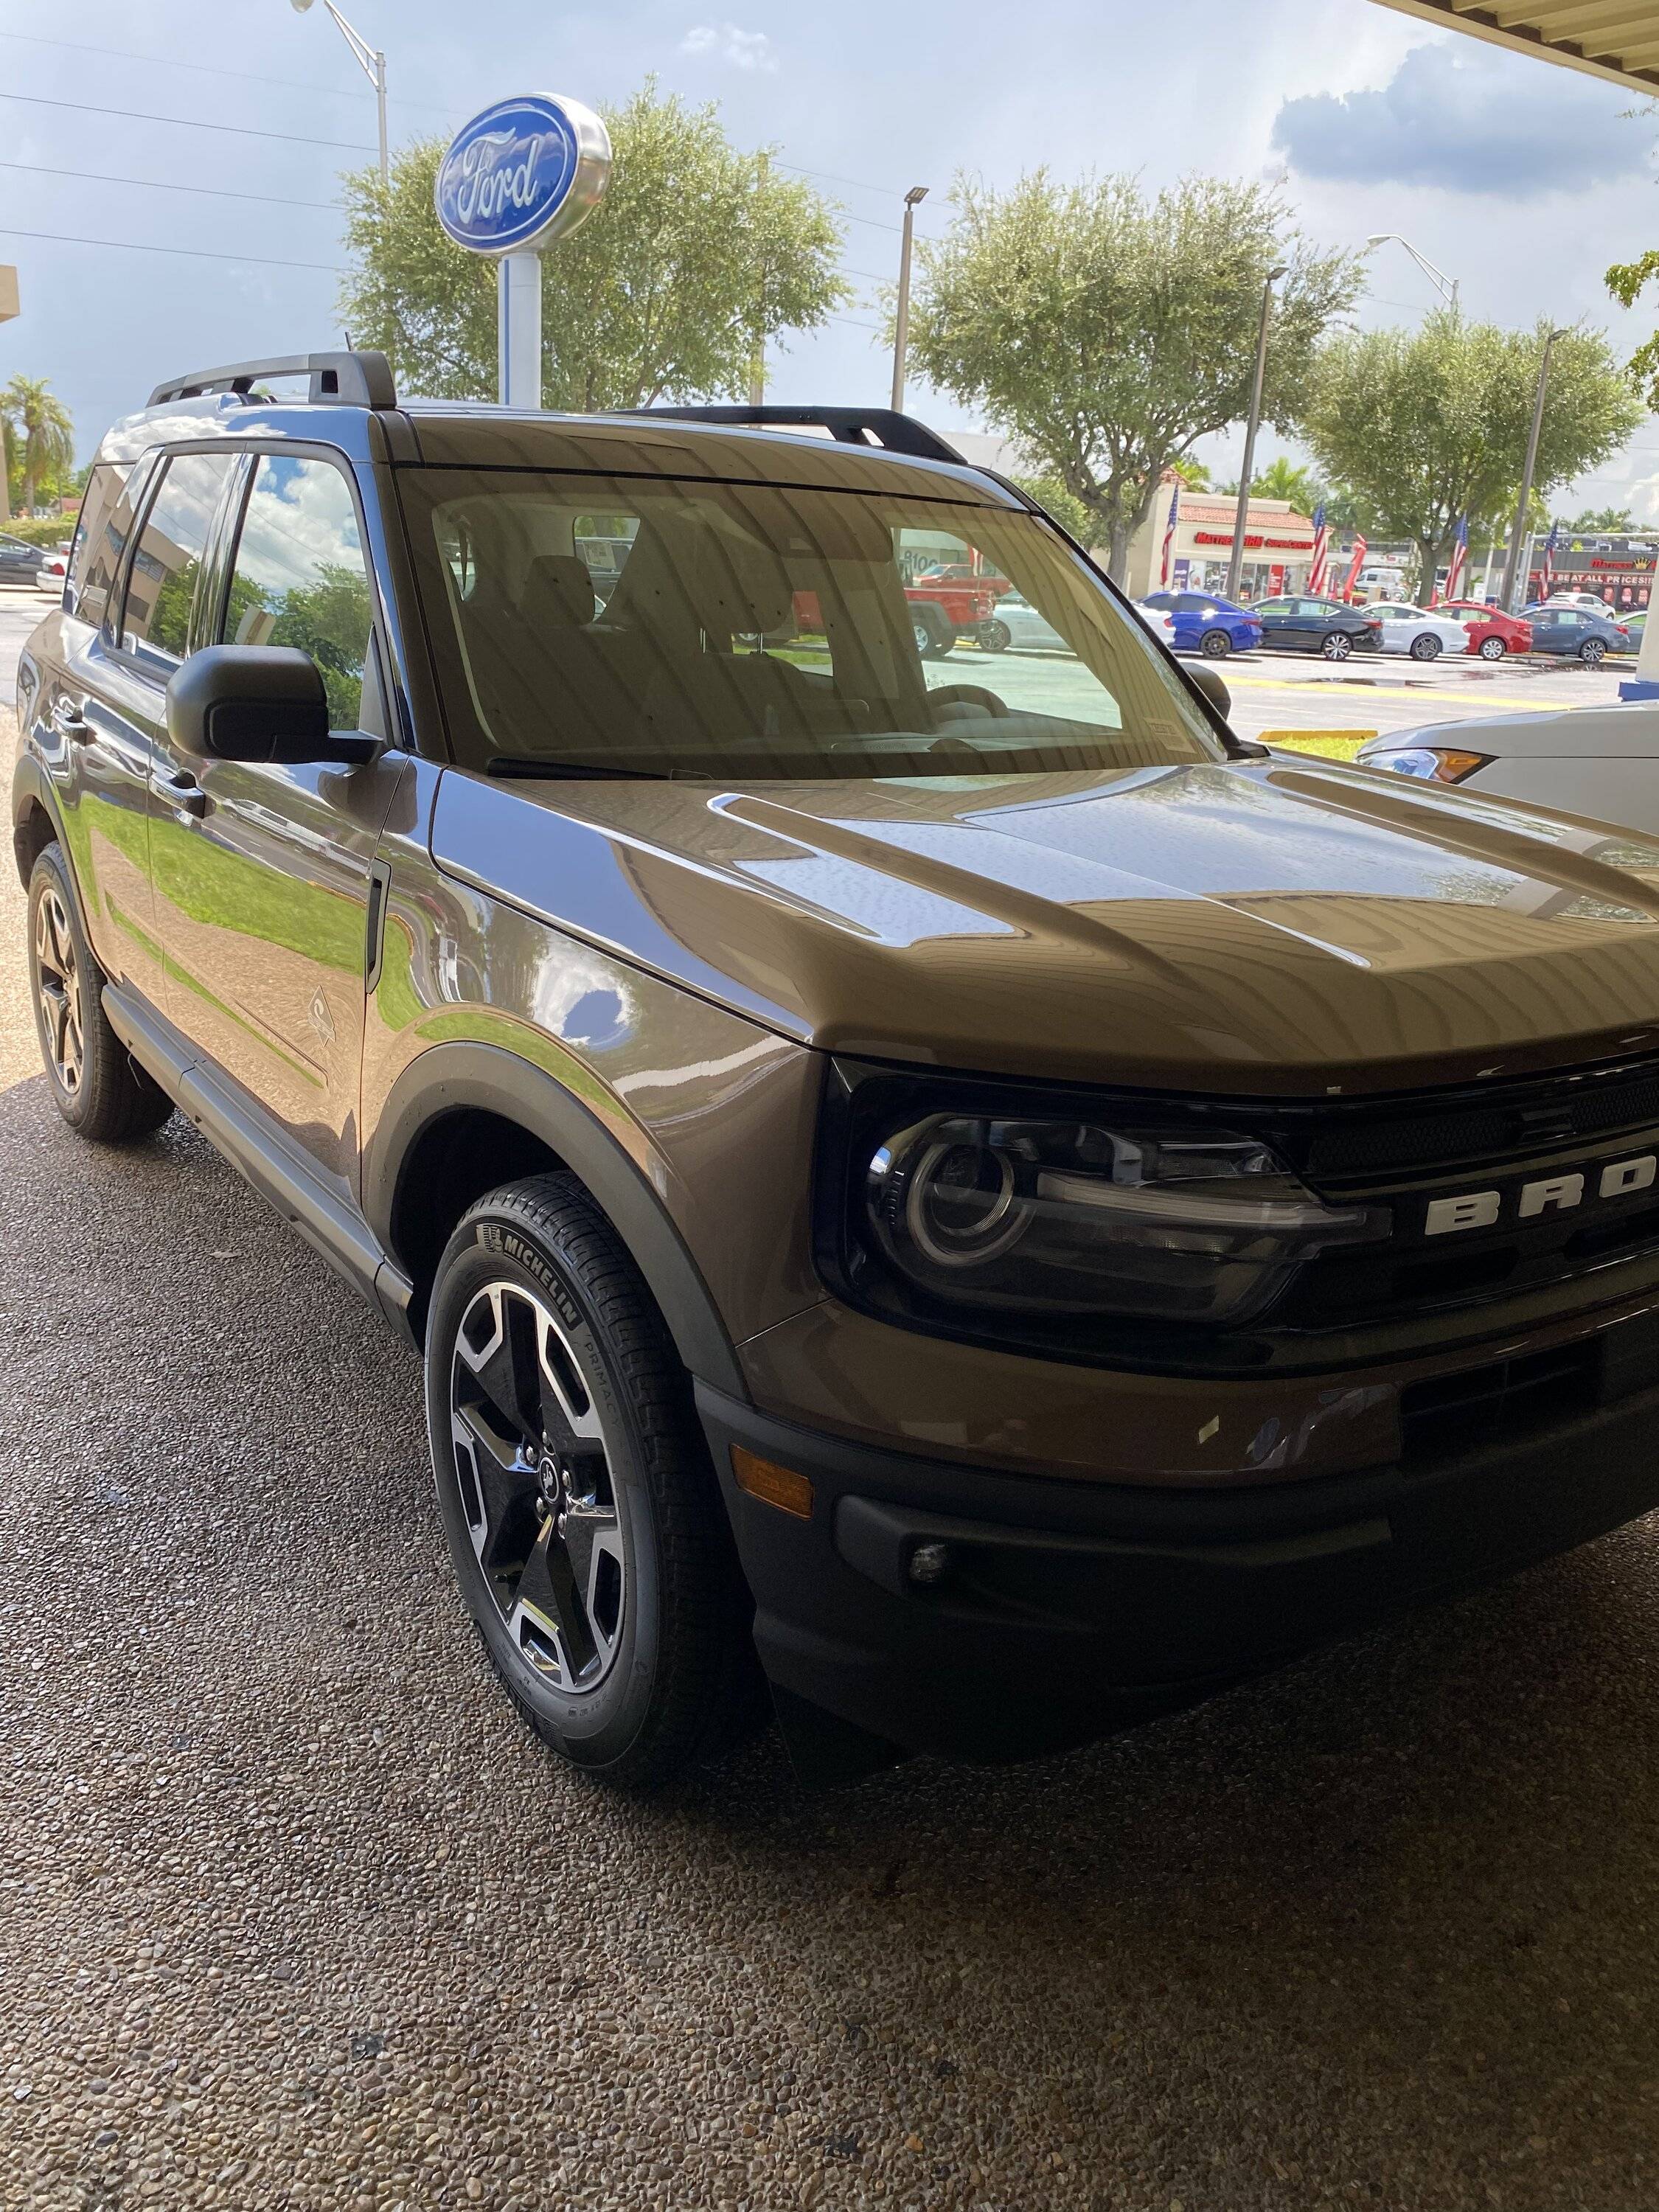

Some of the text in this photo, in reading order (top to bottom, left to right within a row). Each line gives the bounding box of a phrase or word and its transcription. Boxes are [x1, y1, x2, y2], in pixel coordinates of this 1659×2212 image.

[457, 127, 538, 223] Ford
[1195, 532, 1234, 546] MATTRE
[1425, 1155, 1657, 1235] BRO
[504, 1234, 577, 1324] MICHELIN
[585, 1342, 621, 1427] PRIMACY
